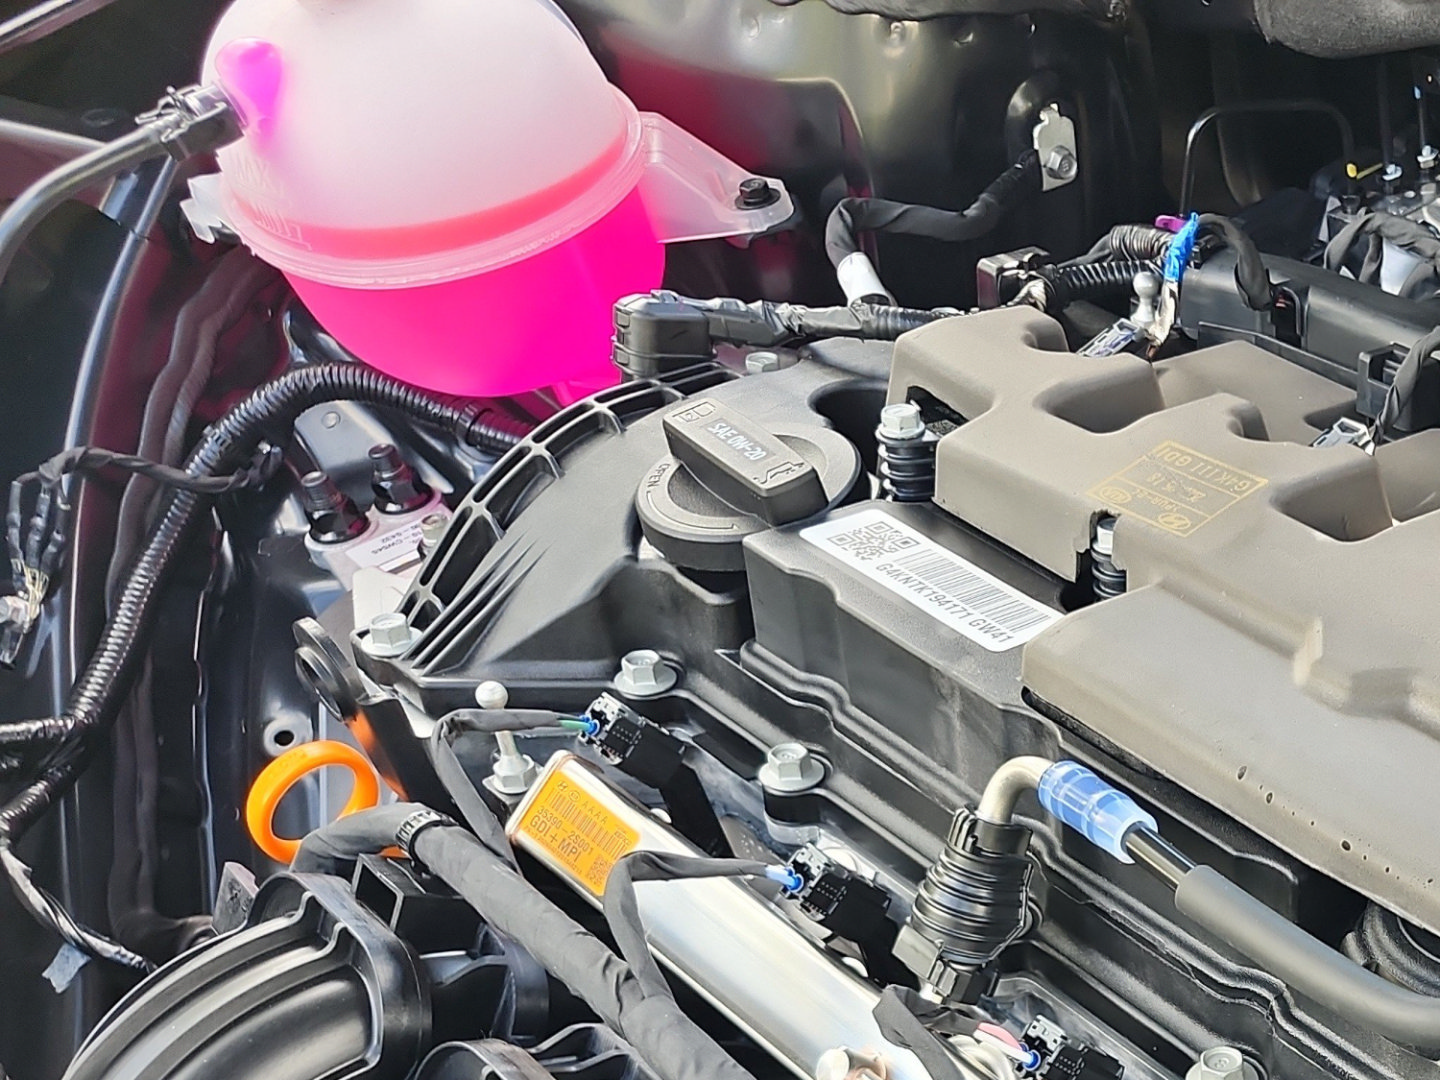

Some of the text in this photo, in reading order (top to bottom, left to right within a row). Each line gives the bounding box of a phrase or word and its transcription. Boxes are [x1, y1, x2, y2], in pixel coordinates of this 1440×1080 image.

[707, 418, 767, 462] SAE 0W-20
[876, 562, 1015, 643] G4KNTK194171 GW41
[528, 814, 552, 837] GDI
[555, 837, 583, 862] MPI
